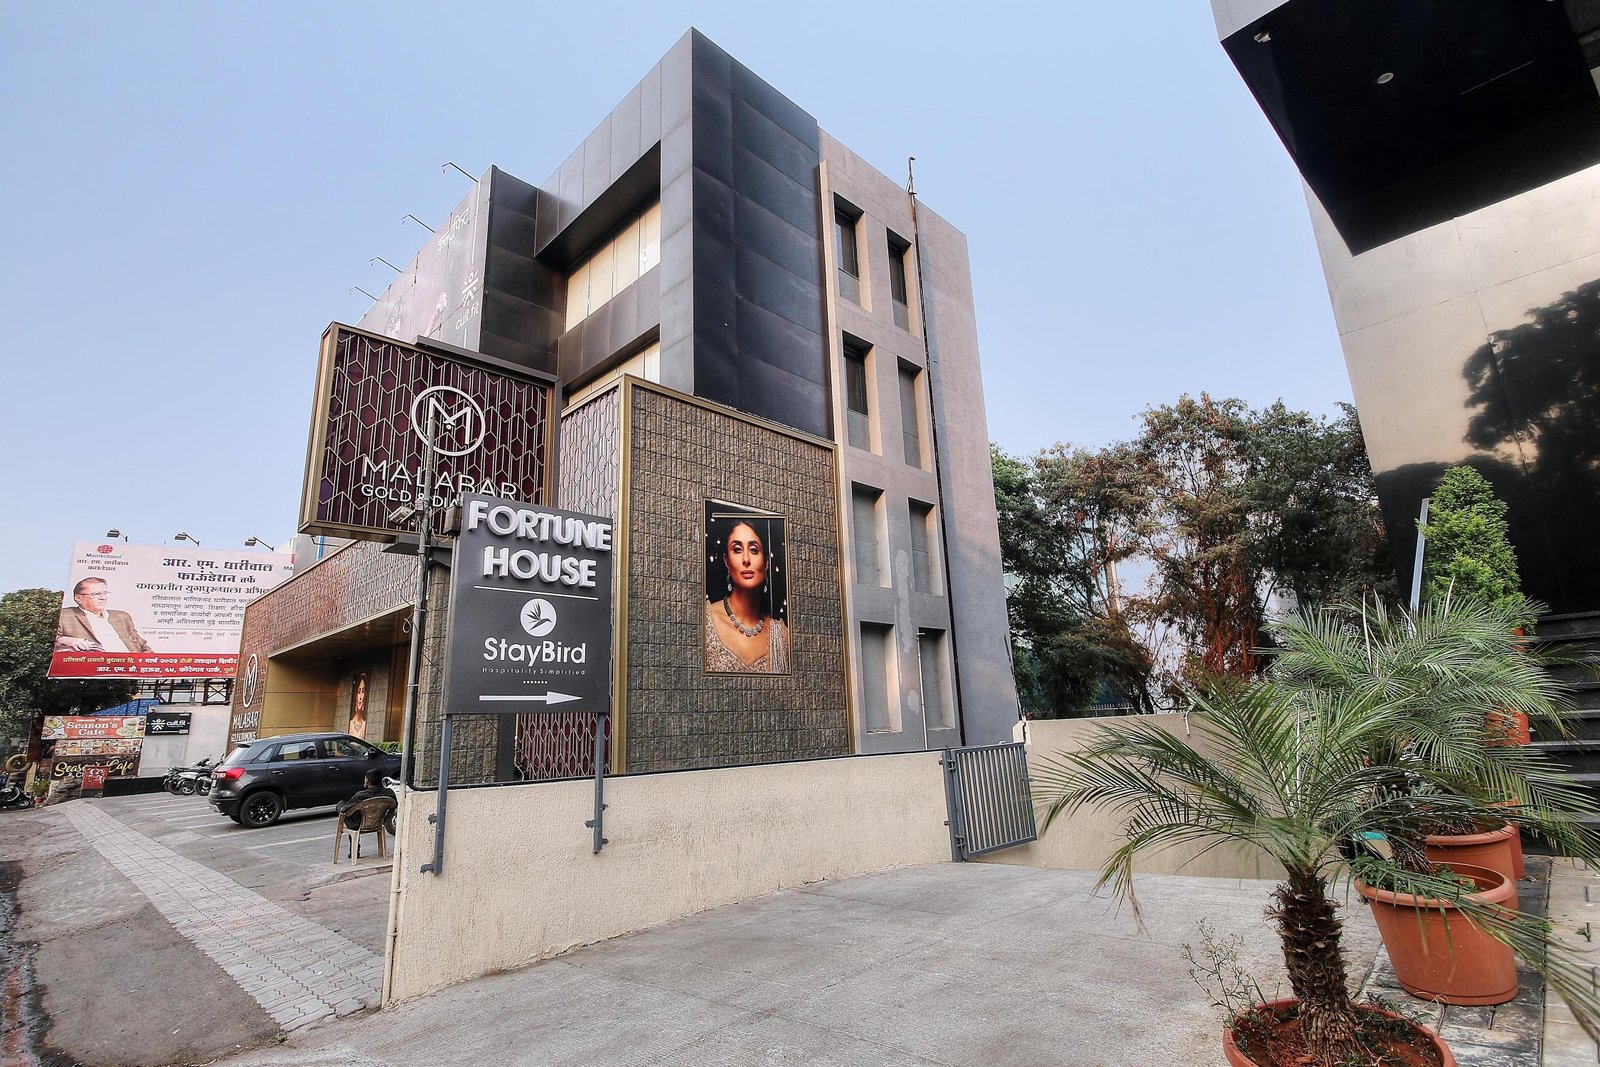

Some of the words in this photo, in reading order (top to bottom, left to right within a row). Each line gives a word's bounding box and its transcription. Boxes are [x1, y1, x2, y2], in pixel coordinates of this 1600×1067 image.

[363, 456, 517, 500] MALABAR
[361, 484, 412, 502] GOLD
[468, 500, 612, 551] FORTUNE
[163, 558, 191, 567] आर.
[197, 560, 218, 569] एम.
[224, 559, 273, 571] धारीवाल
[483, 546, 597, 587] HOUSE
[136, 583, 182, 591] कालातीत
[483, 637, 586, 666] StayBird
[482, 667, 538, 675] Hospitality
[66, 721, 118, 729] Season's
[232, 711, 259, 730] MALABAR
[78, 728, 105, 736] Cafe
